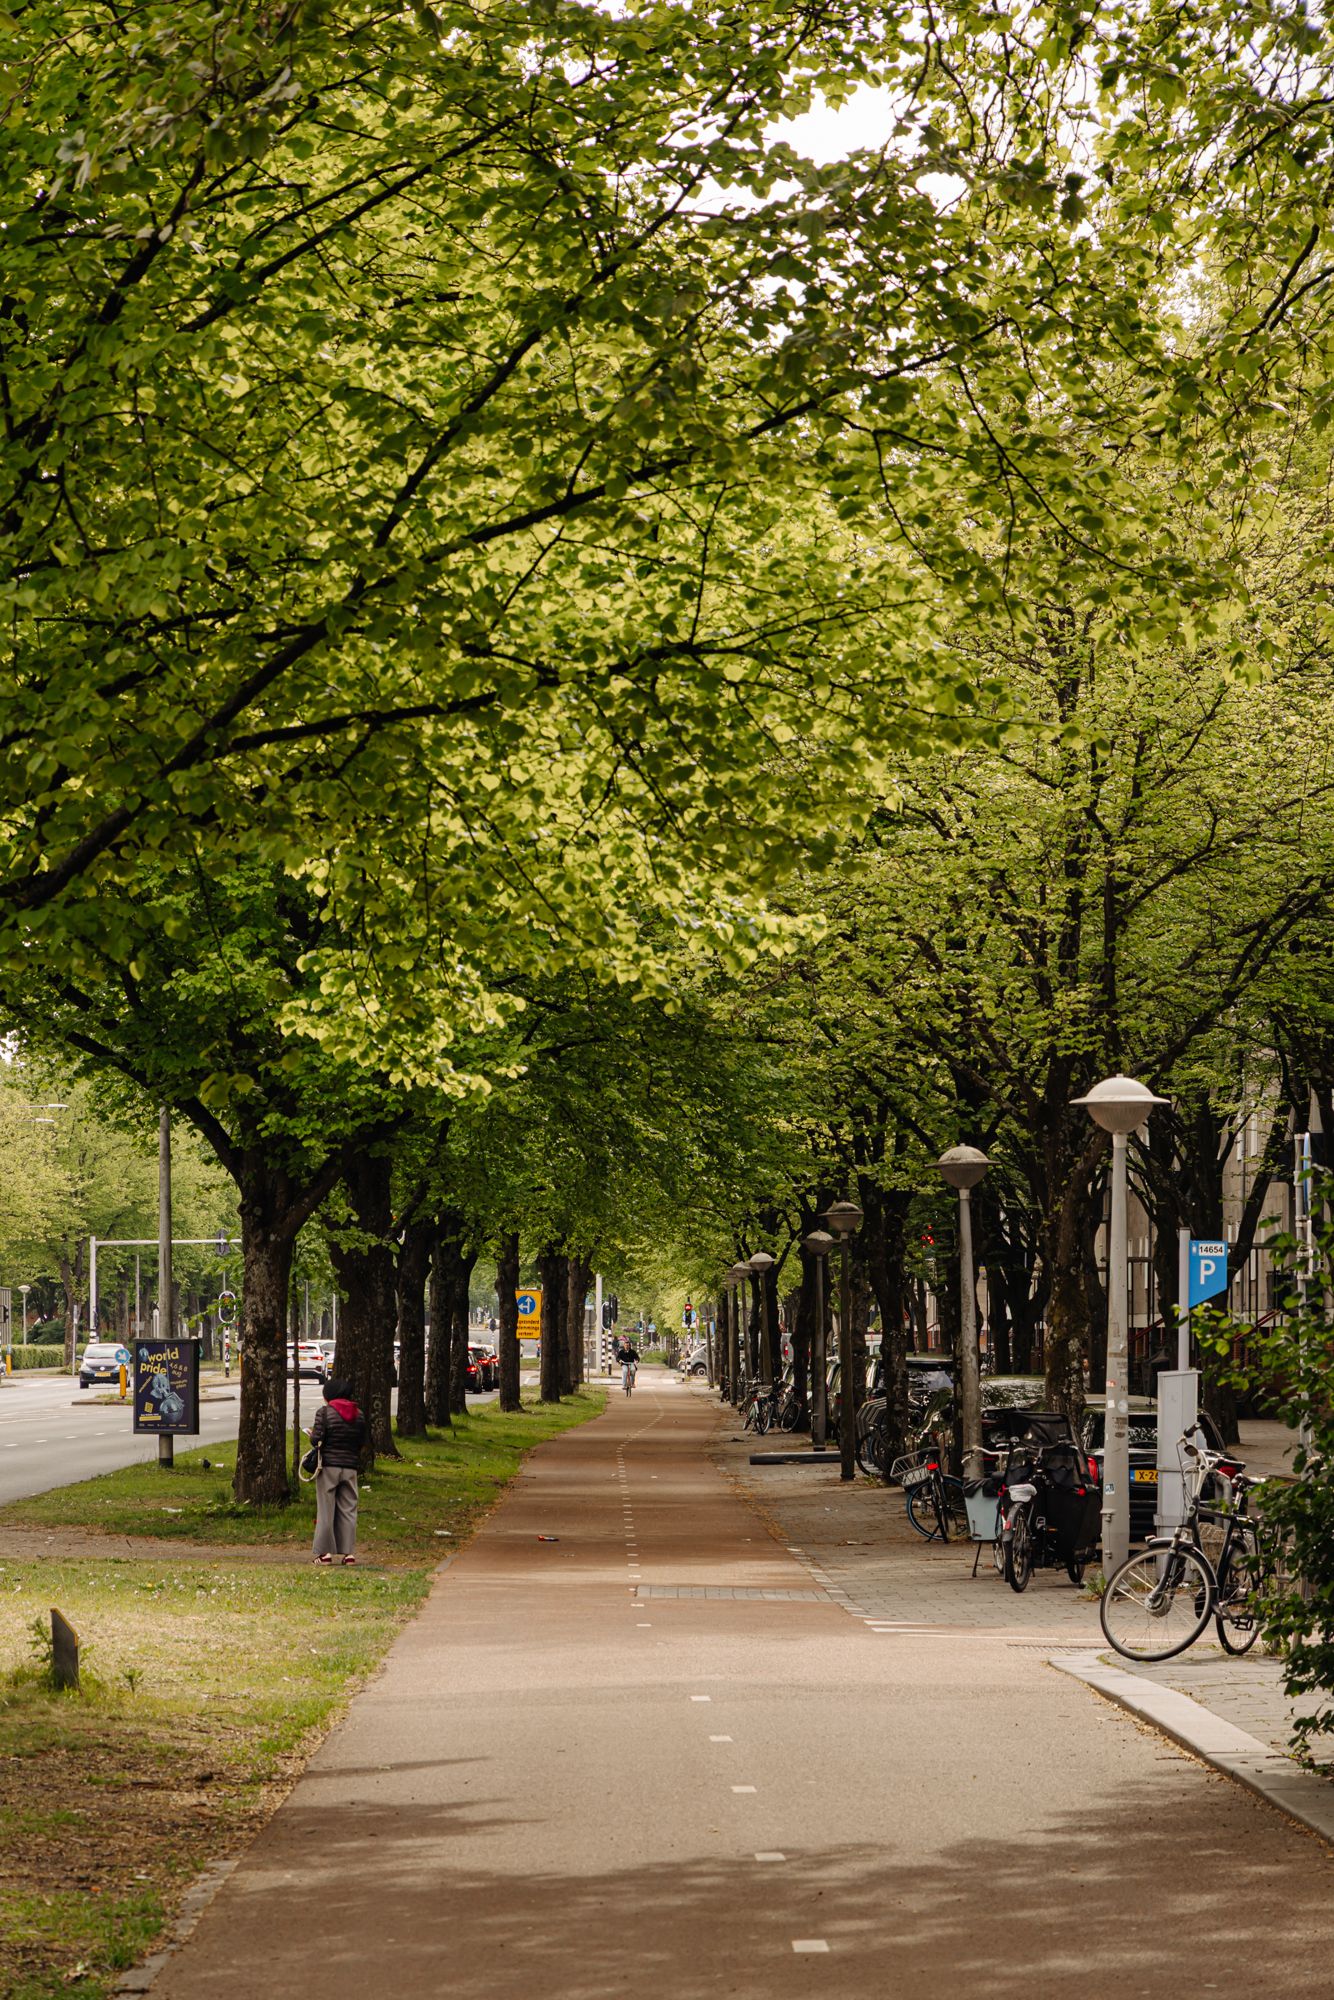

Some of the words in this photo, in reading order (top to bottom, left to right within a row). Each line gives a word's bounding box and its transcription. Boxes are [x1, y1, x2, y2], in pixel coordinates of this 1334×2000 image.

[1200, 1259, 1216, 1285] P
[148, 1347, 179, 1362] world
[140, 1362, 167, 1376] pride
[1139, 1471, 1159, 1480] X-26
